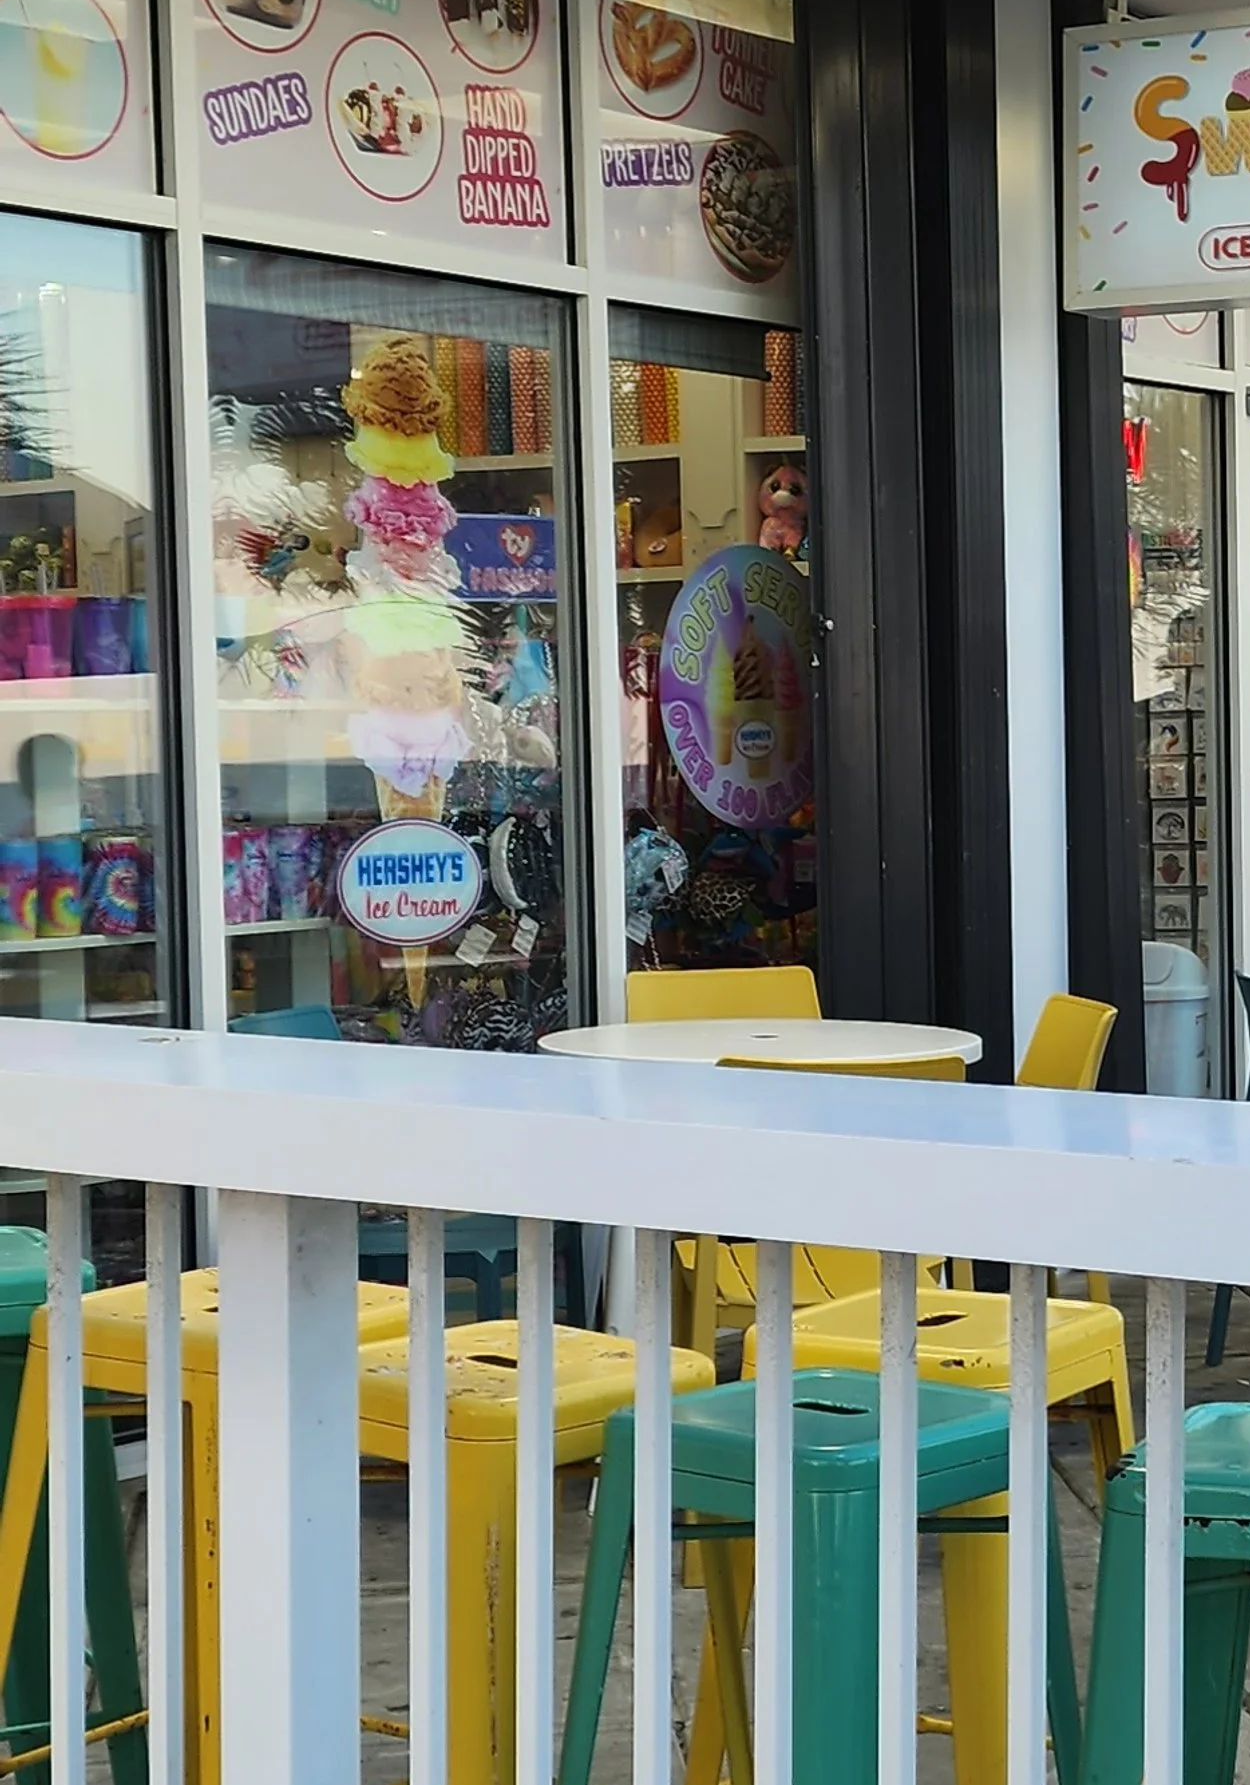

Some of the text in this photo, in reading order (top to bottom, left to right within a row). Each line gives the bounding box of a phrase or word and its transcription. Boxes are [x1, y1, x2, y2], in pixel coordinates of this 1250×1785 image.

[722, 59, 764, 112] CAKE
[206, 78, 309, 140] SUNDAES
[468, 88, 525, 132] HAND
[465, 134, 533, 178] DIPPED
[602, 143, 692, 183] PRETZELS
[460, 179, 548, 223] BANANA
[501, 527, 530, 558] ty
[672, 567, 730, 683] SOFT
[668, 702, 715, 793] OVER
[716, 779, 759, 819] 100
[357, 853, 465, 887] HERSHEY'S
[364, 890, 462, 920] Ice Cream
